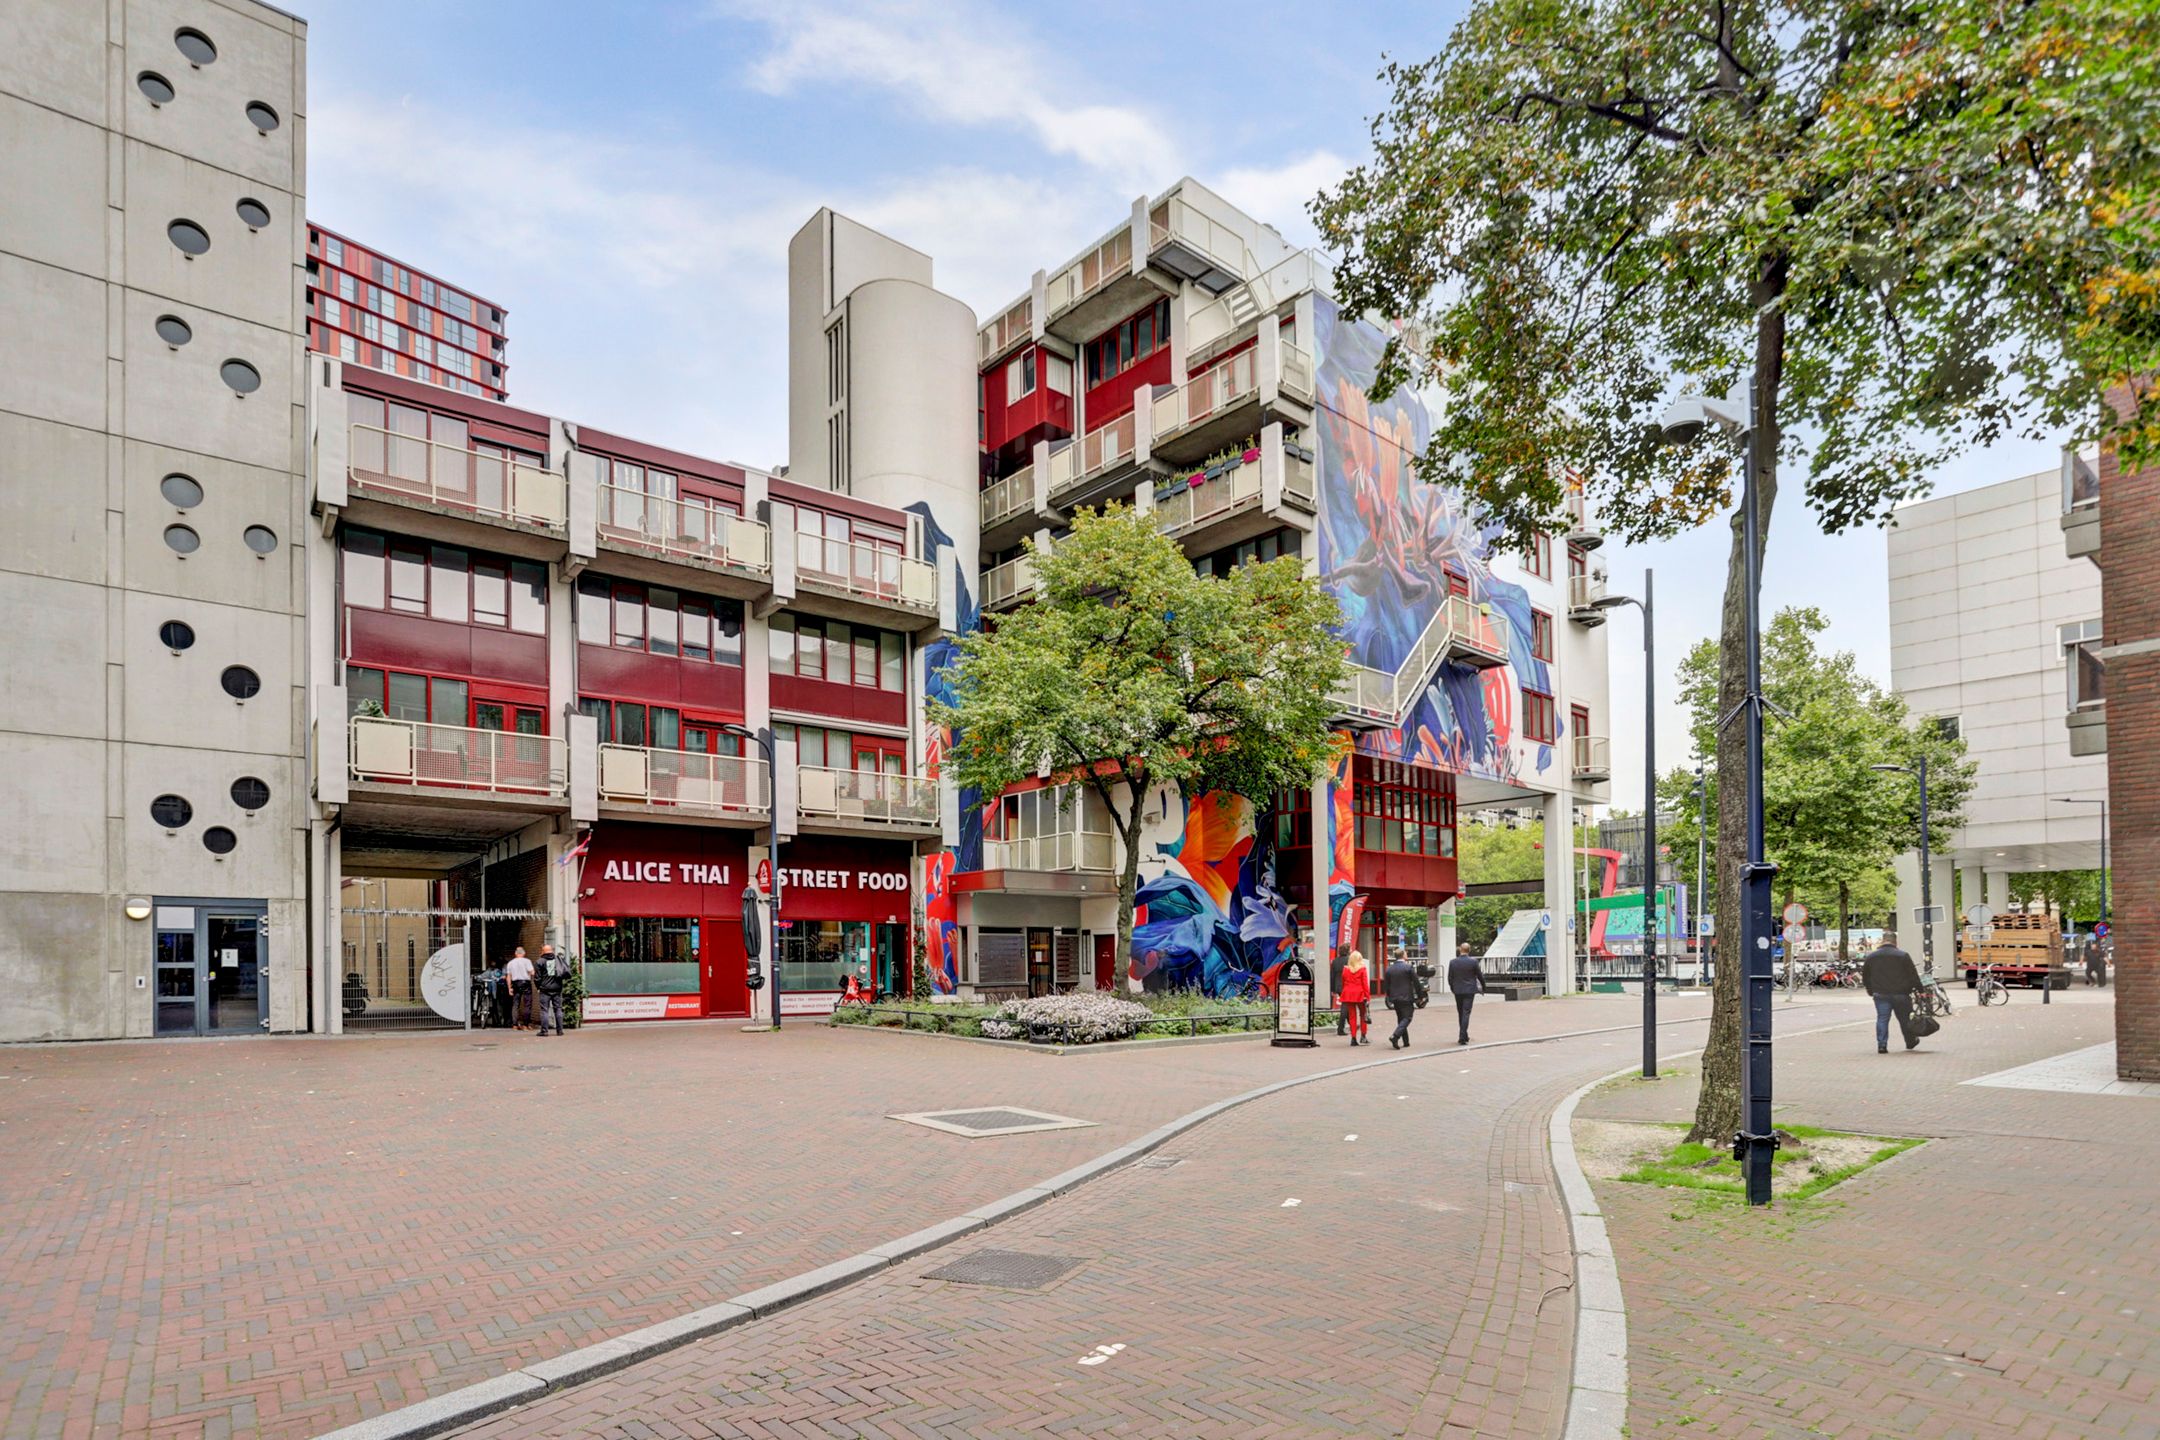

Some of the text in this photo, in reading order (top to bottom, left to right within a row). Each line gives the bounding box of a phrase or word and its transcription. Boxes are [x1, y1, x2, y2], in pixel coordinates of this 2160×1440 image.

[603, 860, 730, 885] ALICE THAI
[777, 867, 908, 891] STREET FOOD
